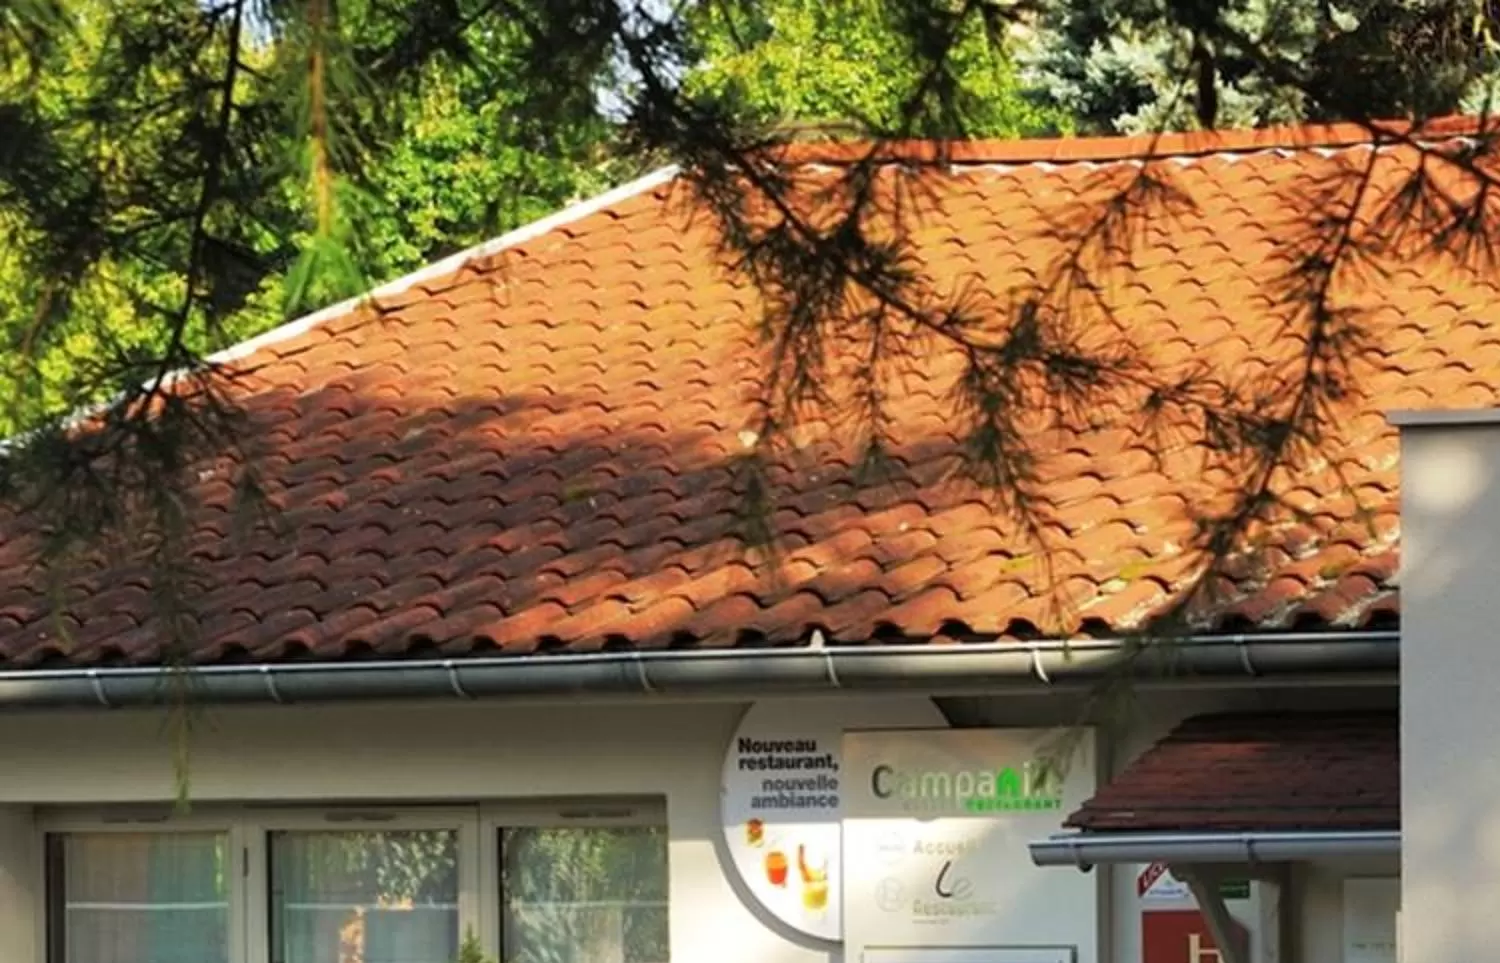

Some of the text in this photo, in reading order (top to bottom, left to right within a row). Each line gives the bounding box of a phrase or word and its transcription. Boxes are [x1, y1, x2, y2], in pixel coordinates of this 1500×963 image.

[737, 736, 817, 754] Nouveau
[738, 753, 839, 773] restaurant,
[761, 773, 839, 792] nouvelle
[871, 760, 1063, 812] Campanie
[750, 791, 839, 810] ambiance
